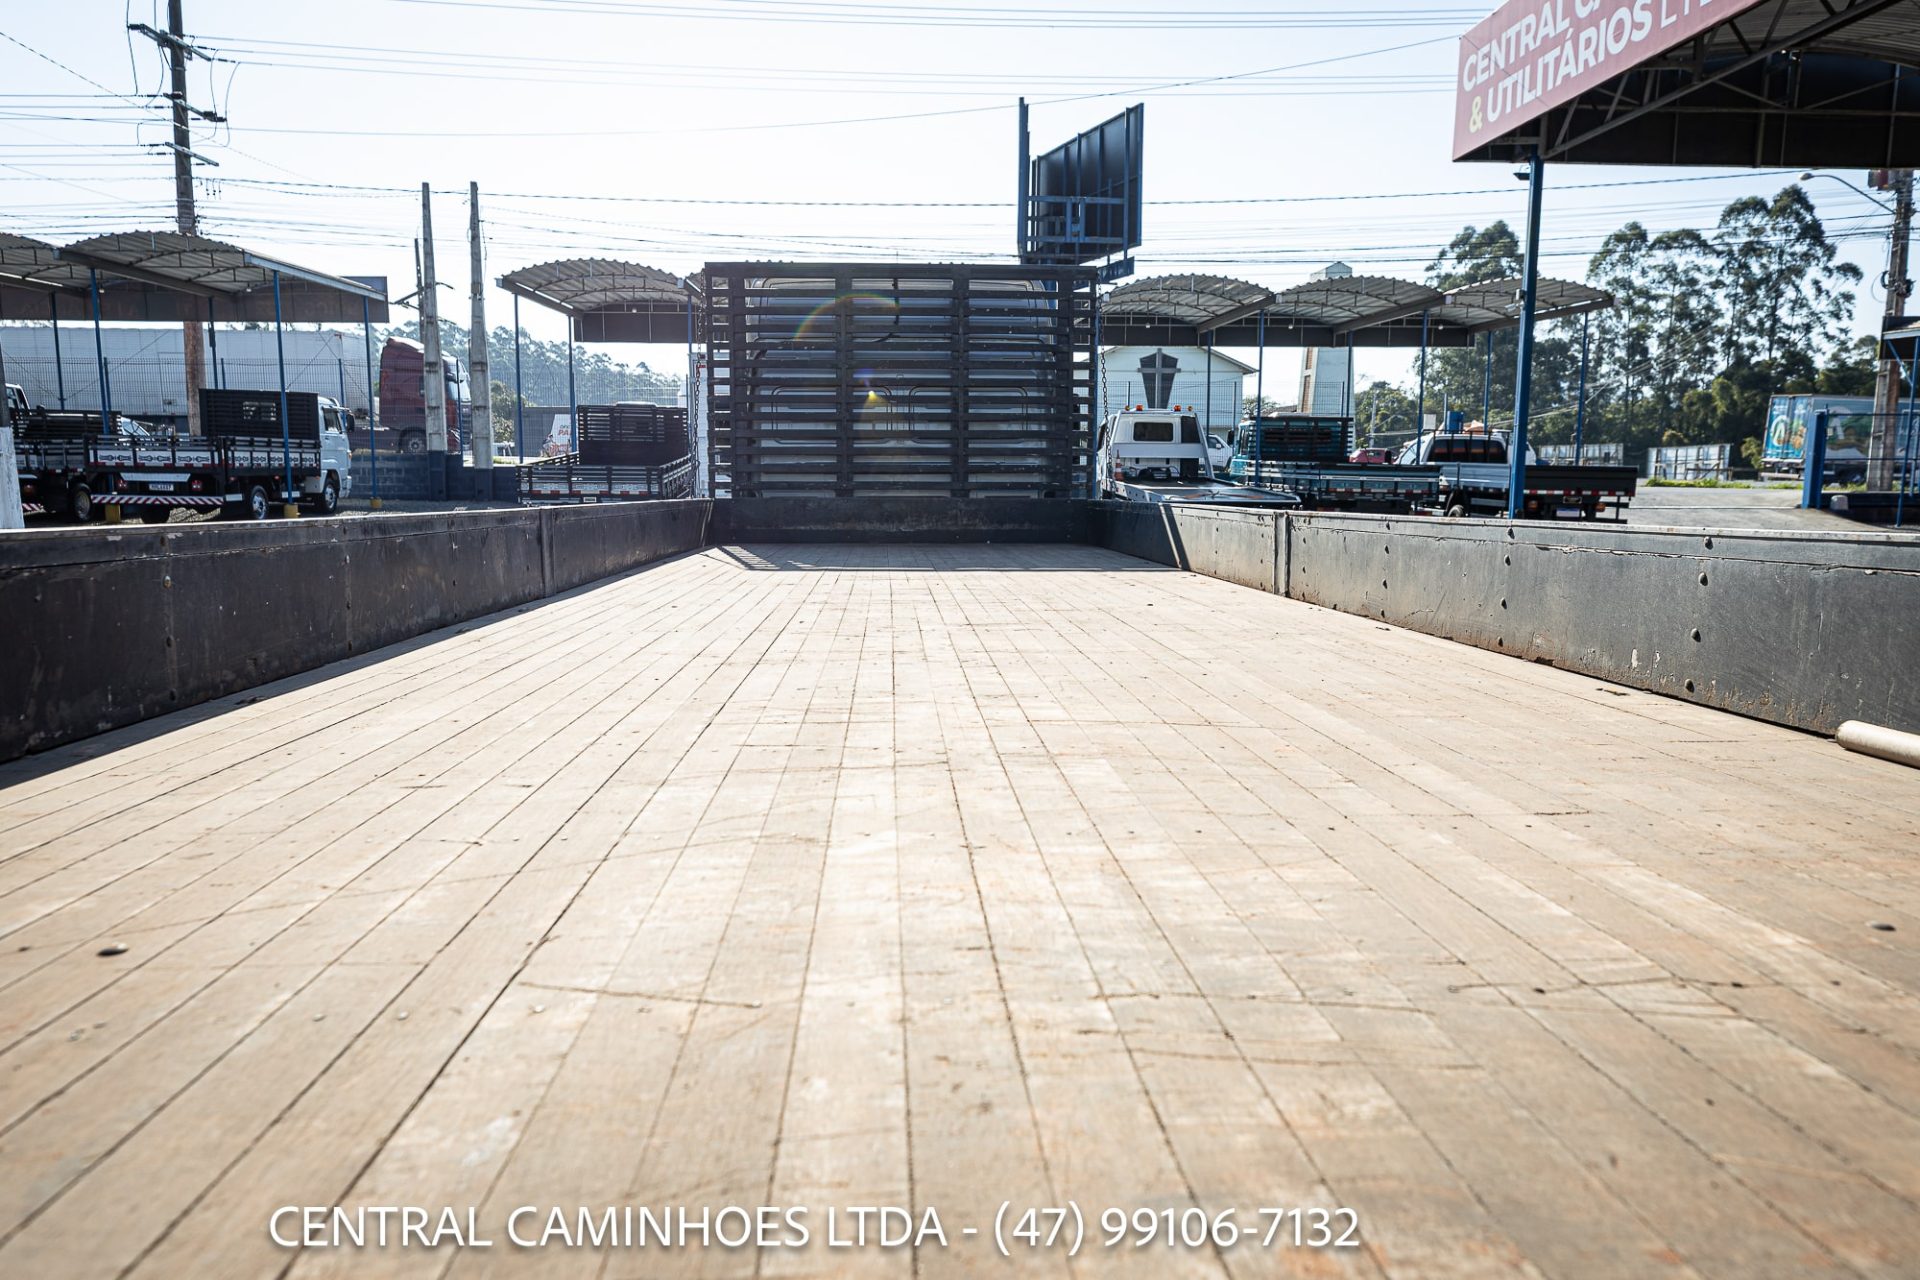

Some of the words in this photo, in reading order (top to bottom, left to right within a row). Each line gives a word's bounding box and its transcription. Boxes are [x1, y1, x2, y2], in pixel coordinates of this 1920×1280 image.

[1463, 0, 1570, 92] CENTRAL
[1469, 96, 1483, 133] &
[1487, 0, 1653, 122] UTILITÁRIOS
